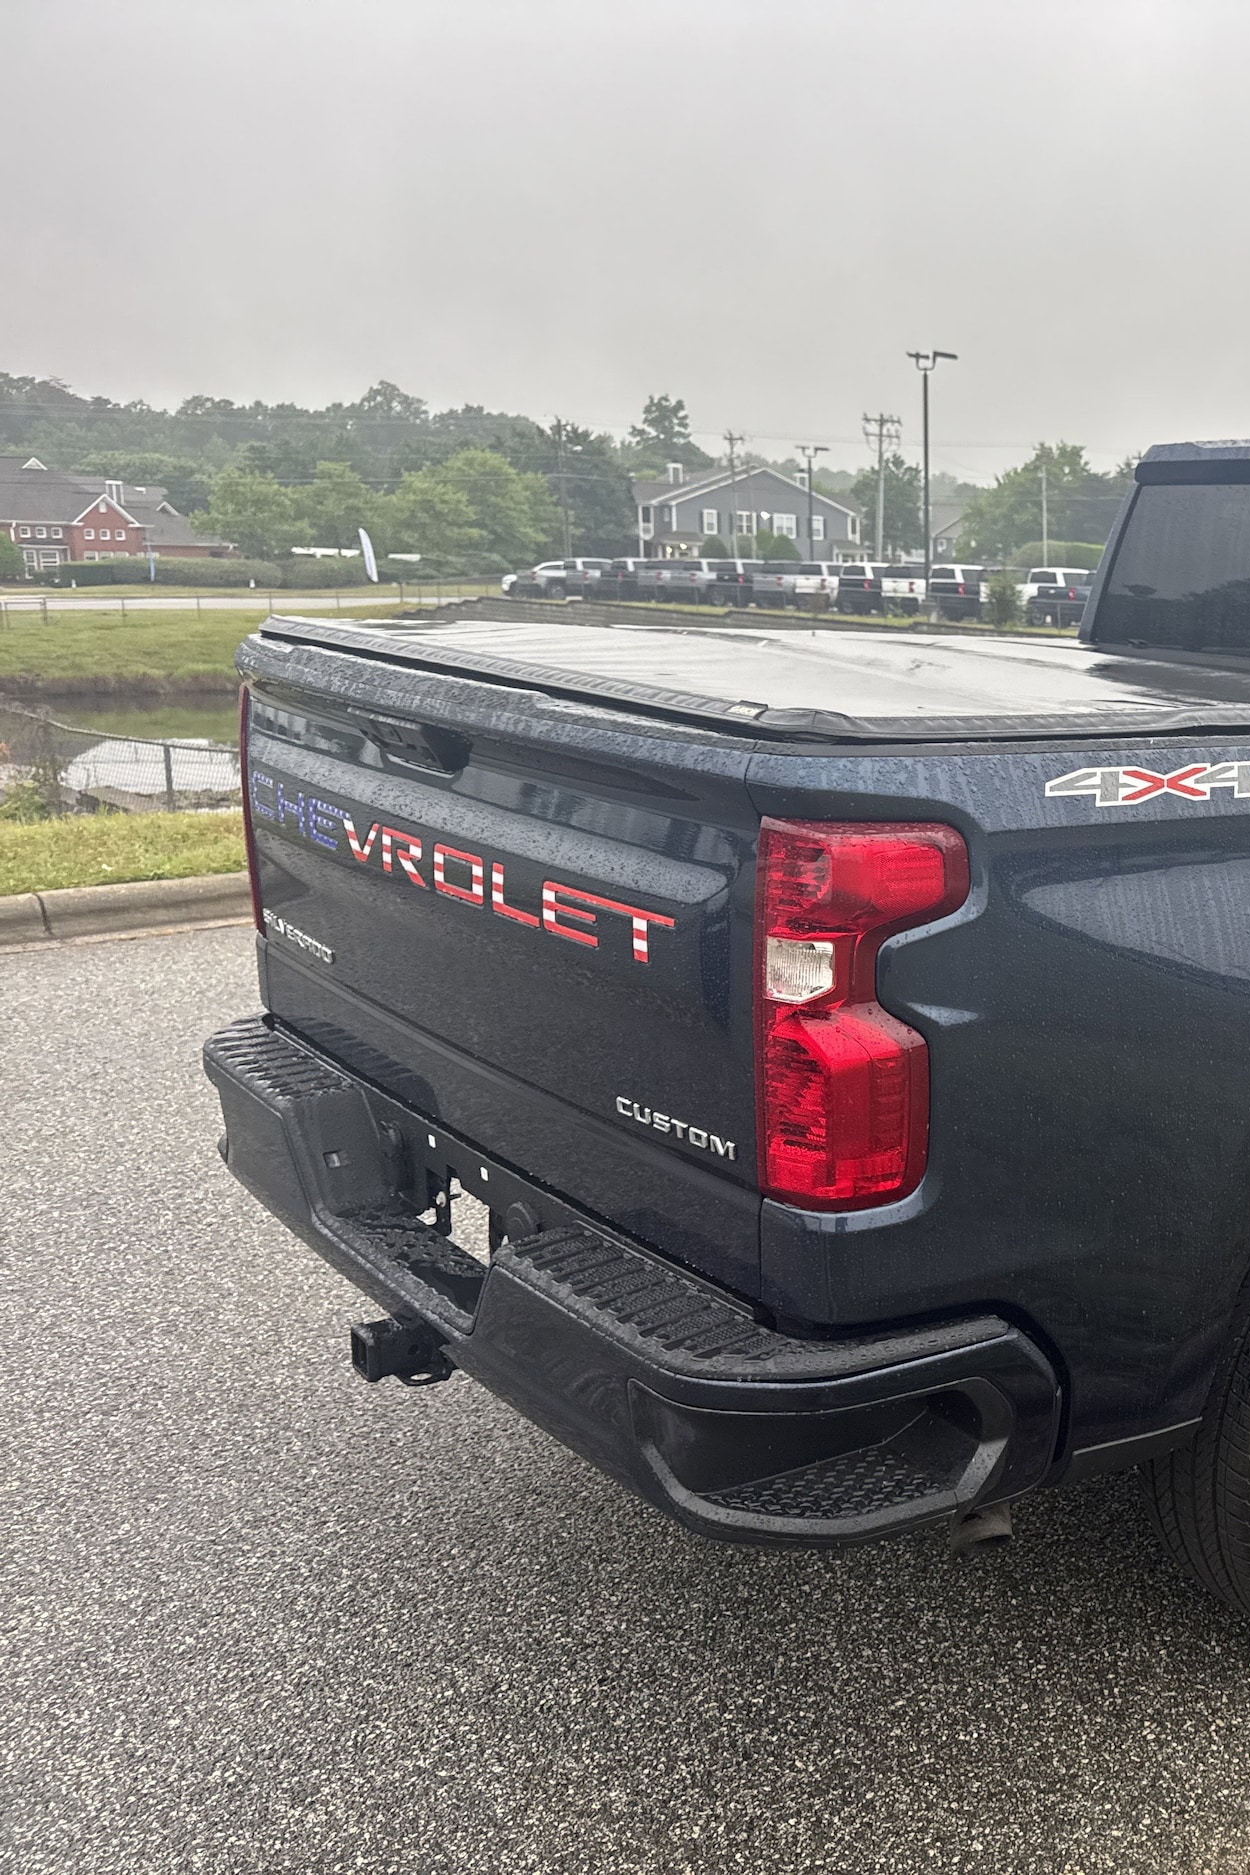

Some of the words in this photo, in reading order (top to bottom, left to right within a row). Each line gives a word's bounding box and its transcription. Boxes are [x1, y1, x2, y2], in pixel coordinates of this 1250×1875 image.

[252, 770, 676, 964] CHEVROLET
[263, 908, 333, 964] SILVERADO
[616, 1096, 736, 1161] CUSTOM
